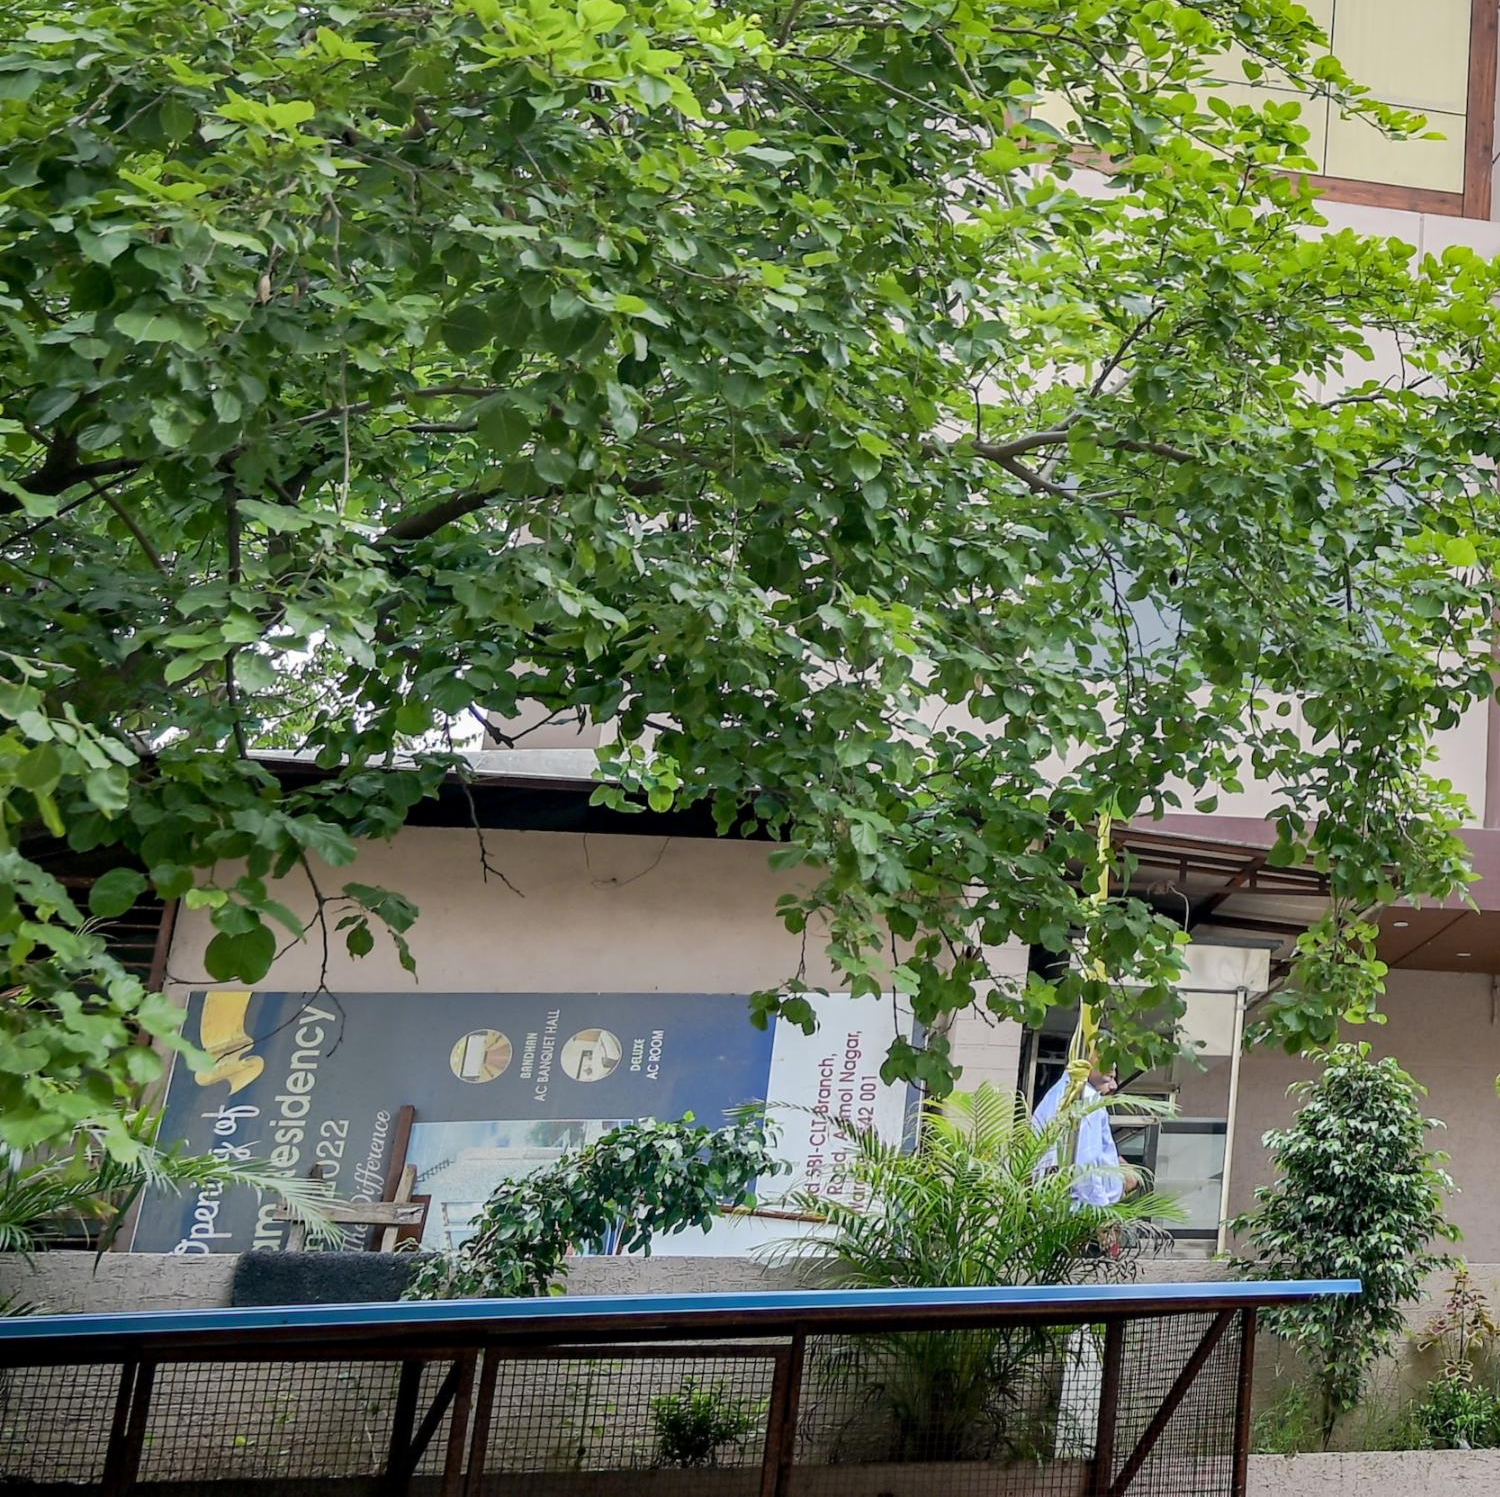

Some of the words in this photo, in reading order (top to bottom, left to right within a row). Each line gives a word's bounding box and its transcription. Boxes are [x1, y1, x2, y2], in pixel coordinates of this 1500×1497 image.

[546, 1009, 560, 1035] HALL
[537, 1036, 557, 1082] BANQUET
[630, 1038, 645, 1071] DELUXE
[648, 1030, 664, 1062] ROOM
[838, 1030, 862, 1082] Nagar,
[646, 1062, 660, 1080] AC
[814, 1053, 837, 1114] Branch,
[266, 1005, 336, 1181] esidency
[534, 1085, 547, 1102] AC
[860, 1075, 877, 1102] 001
[201, 1105, 260, 1136] of
[806, 1119, 827, 1177] SBI-CLT
[169, 1141, 251, 1255] Openig
